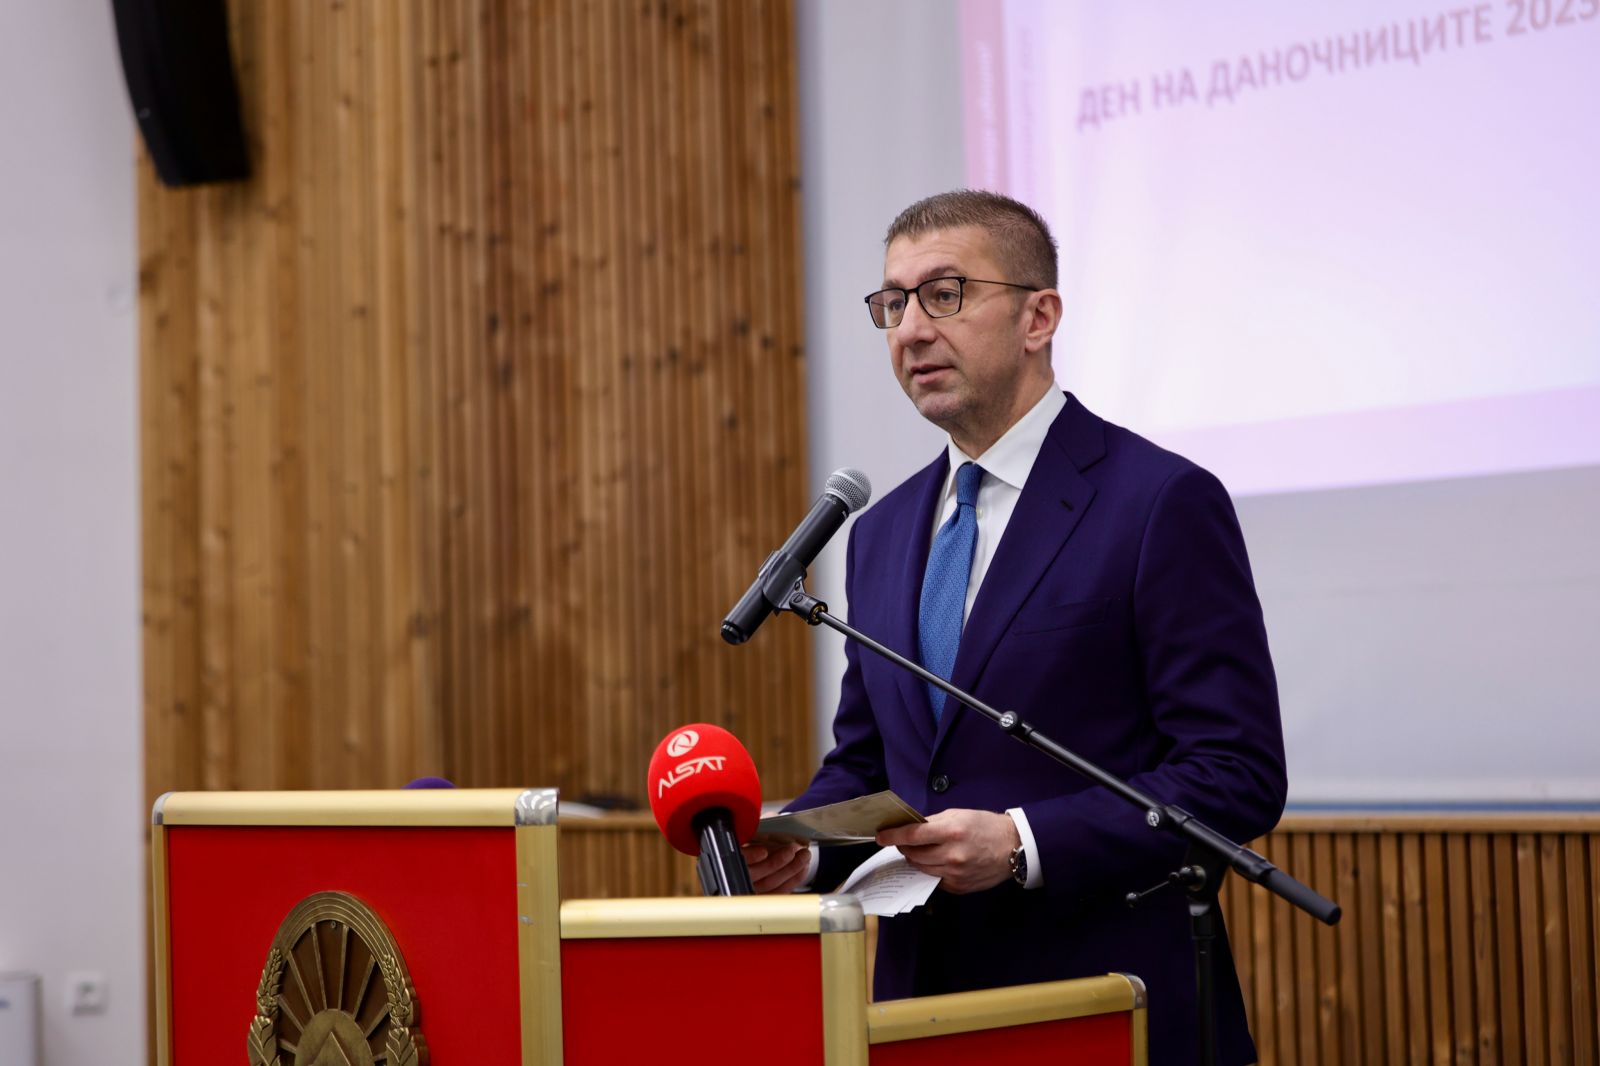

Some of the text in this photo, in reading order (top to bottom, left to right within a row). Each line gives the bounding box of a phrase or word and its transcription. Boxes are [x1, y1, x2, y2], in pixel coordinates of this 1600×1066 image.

[1077, 79, 1141, 132] ДЕН
[1151, 68, 1198, 108] НА
[1206, 3, 1493, 106] ДАНОЧНИЦИТЕ
[658, 756, 727, 799] ALSAT
